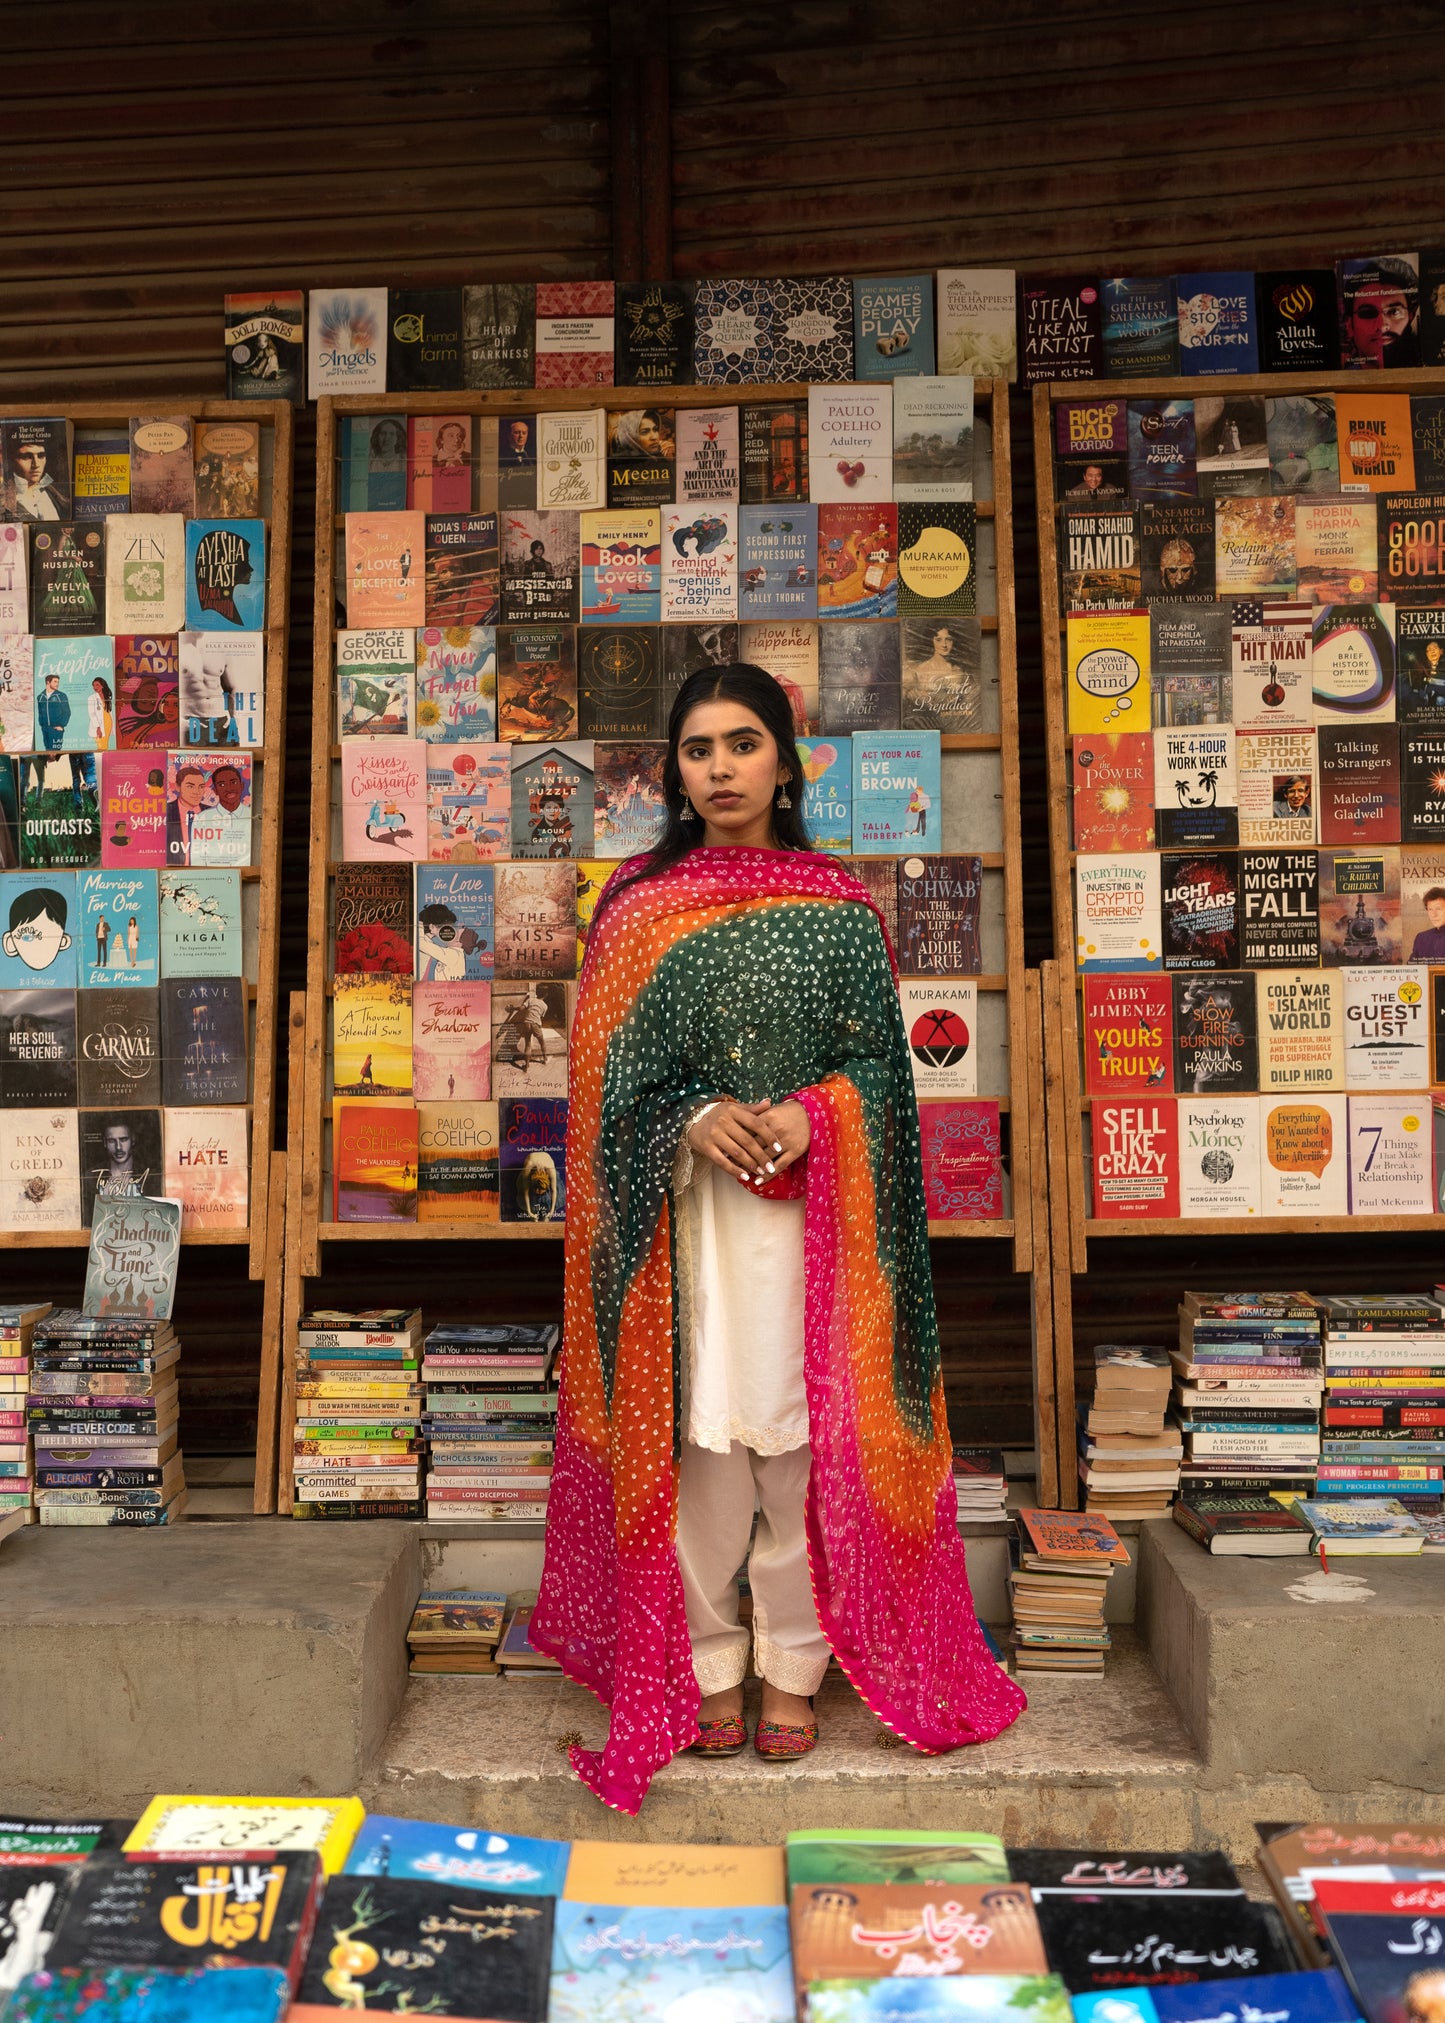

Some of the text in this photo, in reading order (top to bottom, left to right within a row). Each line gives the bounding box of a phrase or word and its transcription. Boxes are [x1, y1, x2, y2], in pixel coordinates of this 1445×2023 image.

[1378, 287, 1418, 297] Fundamentalist
[861, 294, 922, 308] GAMES
[947, 303, 985, 311] WOMAN
[1111, 301, 1166, 313] GREATEST
[1211, 296, 1247, 310] LOVE
[1028, 296, 1088, 320] STEAL
[1190, 310, 1247, 324] STORIES
[232, 321, 293, 340] DOLL BONES
[483, 325, 518, 337] HEART
[861, 319, 921, 337] PLAY
[1029, 321, 1089, 336] LIKE AN
[1276, 325, 1315, 339] Allah
[319, 349, 376, 367] Angels
[420, 346, 457, 361] farm
[636, 364, 673, 378] Allah
[744, 410, 758, 420] MY
[1069, 407, 1111, 425] RICH
[744, 420, 772, 430] NAME
[821, 420, 881, 432] COELHO
[558, 426, 583, 441] JULIE
[1069, 423, 1114, 441] DAD
[702, 441, 718, 451] ZEN
[1150, 444, 1179, 454] TEEN
[612, 468, 670, 486] Meena
[84, 483, 119, 495] TEENS
[1386, 499, 1432, 509] NAPOLEON
[1313, 506, 1352, 518] ROBIN
[1143, 523, 1213, 536] DARK AGES
[1318, 531, 1348, 540] MONK
[434, 535, 466, 544] QUEEN
[745, 534, 808, 546] SECOND FIRST
[124, 538, 165, 561] ZEN
[197, 531, 245, 564] AYESHA
[1068, 534, 1134, 571] HAMID
[1222, 542, 1269, 554] Reclaim
[52, 550, 84, 559] SEVEN
[599, 549, 647, 567] Book
[903, 551, 966, 562] MURAKAMI
[671, 556, 717, 568] remind
[352, 577, 416, 589] DECEPTION
[526, 590, 552, 605] BIRD
[516, 634, 558, 643] LEO TOLSTOY
[757, 626, 801, 639] How It
[1159, 631, 1202, 639] CINEPHILIA
[344, 637, 405, 648] GEORGE
[1240, 641, 1306, 661] HIT MAN
[1338, 652, 1363, 660] BRIEF
[37, 649, 112, 679] Exception
[429, 647, 476, 672] Never
[1087, 675, 1129, 688] mind
[912, 695, 973, 713] Prejudice
[188, 717, 257, 744] DEAL
[587, 723, 648, 733] OLIVIE BLAKE
[1334, 742, 1379, 755] Talking
[359, 757, 401, 774] Kisses
[861, 762, 890, 775] EVE
[1167, 756, 1228, 770] WORK WEEK
[525, 776, 581, 784] PAINTED
[1086, 768, 1144, 788] POWER
[108, 798, 167, 814] RIGHT
[25, 818, 93, 836] OUTCASTS
[1240, 819, 1313, 831] STEPHEN
[193, 828, 223, 841] NOT
[1243, 855, 1316, 870] HOW THE
[1349, 872, 1381, 881] RAILWAY
[83, 874, 144, 893] Marriage
[902, 880, 976, 898] SCHWAB
[343, 885, 401, 897] MAURIER
[1164, 882, 1212, 903] LIGHT
[424, 893, 494, 904] Hypothesis
[1086, 891, 1144, 906] CRYPTO
[175, 932, 226, 943] IKIGAI
[512, 929, 554, 942] KISS
[502, 948, 561, 962] THIEF
[1245, 944, 1319, 958] JIM COLLINS
[177, 988, 230, 999] CARVE
[909, 990, 971, 1001] MURAKAMI
[342, 1006, 400, 1023] A Thousand
[1193, 1008, 1234, 1021] SLOW
[1347, 1004, 1422, 1020] GUEST
[421, 1018, 480, 1035] Shadows
[9, 1031, 57, 1046] HER SOUL
[1093, 1028, 1163, 1048] YOURS
[82, 1030, 156, 1061] CARAVAL
[183, 1054, 231, 1065] MARK
[1194, 1051, 1232, 1062] PAULA
[1270, 1068, 1333, 1083] DILIP HIRO
[437, 1117, 475, 1130] PAULO
[1101, 1108, 1167, 1135] SELL
[15, 1135, 56, 1147] KING
[343, 1136, 413, 1153] COELHO
[1381, 1139, 1419, 1151] Things
[1357, 1126, 1383, 1173] 7
[178, 1149, 229, 1166] HATE
[355, 1158, 401, 1167] THE VALKYRIES
[9, 1159, 63, 1171] GREED
[1099, 1154, 1167, 1175] CRAZY
[1358, 1171, 1424, 1184] Relationship
[108, 1218, 170, 1243] Shadow
[1238, 1308, 1266, 1317] COSMIC
[365, 1334, 395, 1346] Bloodline
[70, 1423, 106, 1434] FEVER
[106, 1423, 136, 1434] CODE
[45, 1473, 92, 1484] ALLEGIANT
[117, 1476, 145, 1485] ROTH
[1245, 1479, 1271, 1487] POTTER
[160, 1864, 289, 1948] اقبال
[851, 1900, 993, 1960] پنجاب
